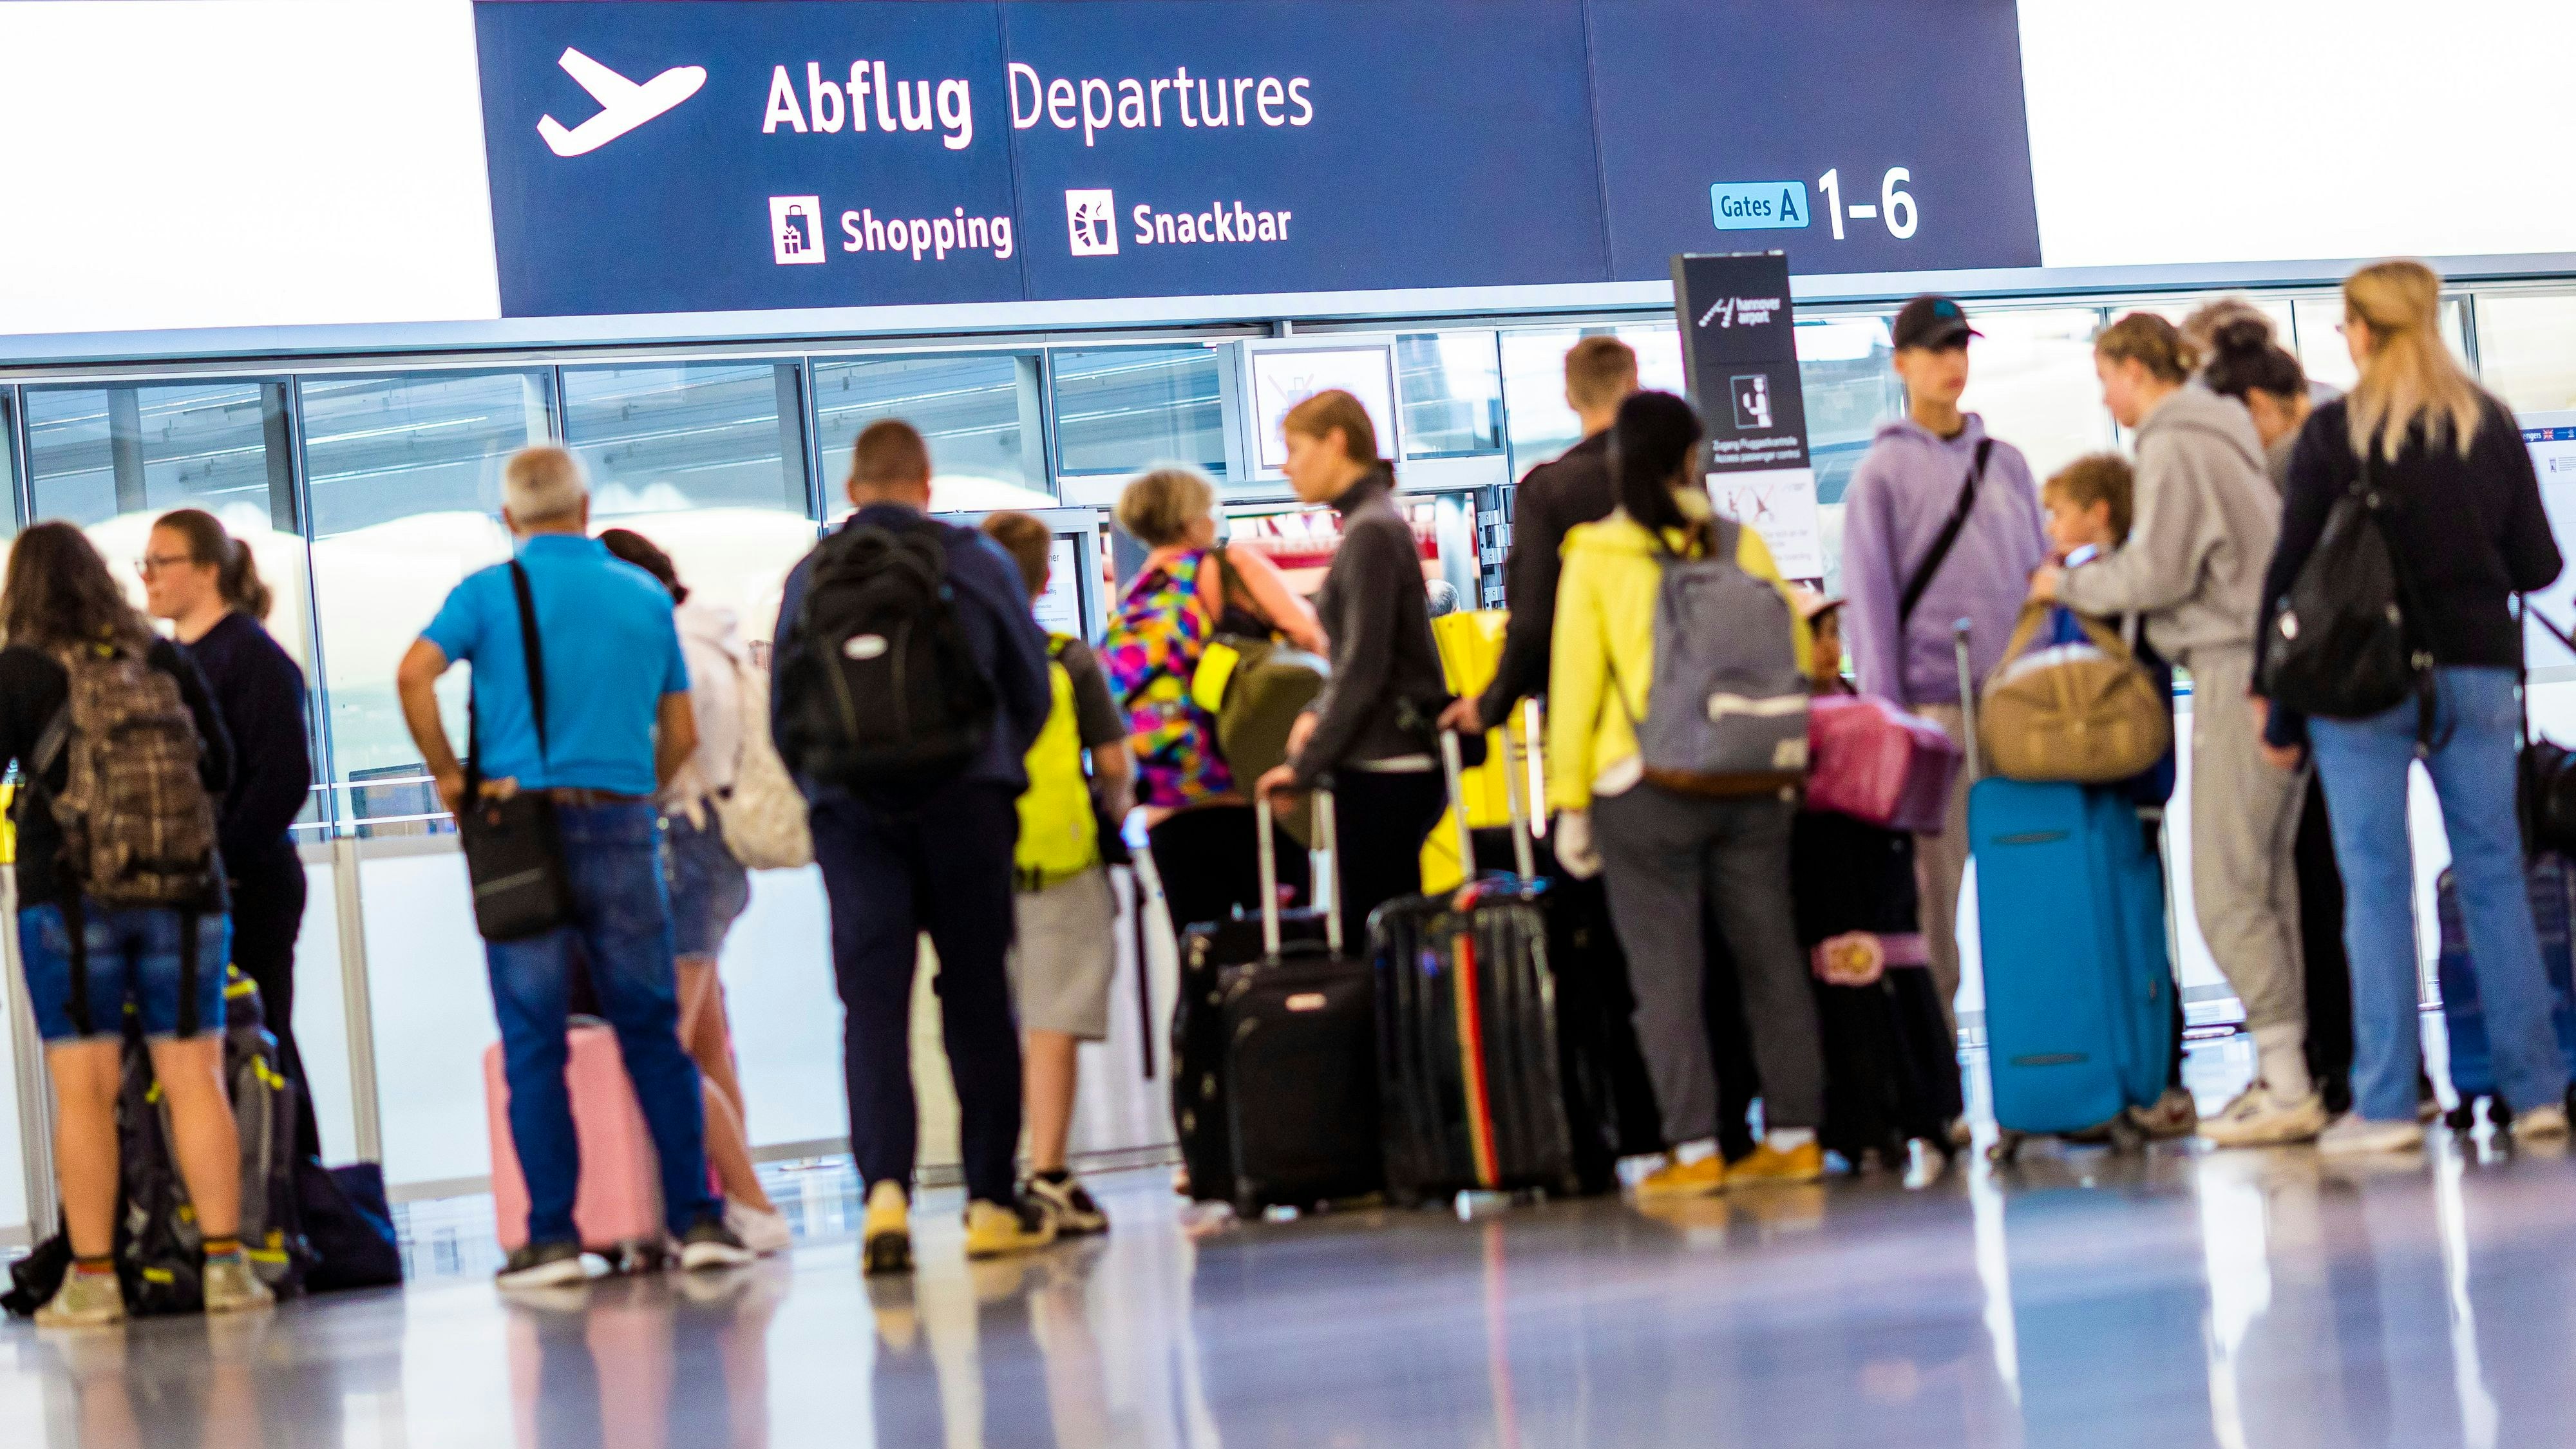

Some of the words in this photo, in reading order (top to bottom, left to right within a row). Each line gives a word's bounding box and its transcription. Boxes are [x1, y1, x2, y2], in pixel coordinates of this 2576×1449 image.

[762, 60, 973, 150] Abflug
[1008, 62, 1314, 147] Departures
[1133, 201, 1292, 244] Snackbar
[1721, 195, 1772, 218] Gates
[1779, 188, 1799, 222] A
[842, 207, 1013, 261] Shopping
